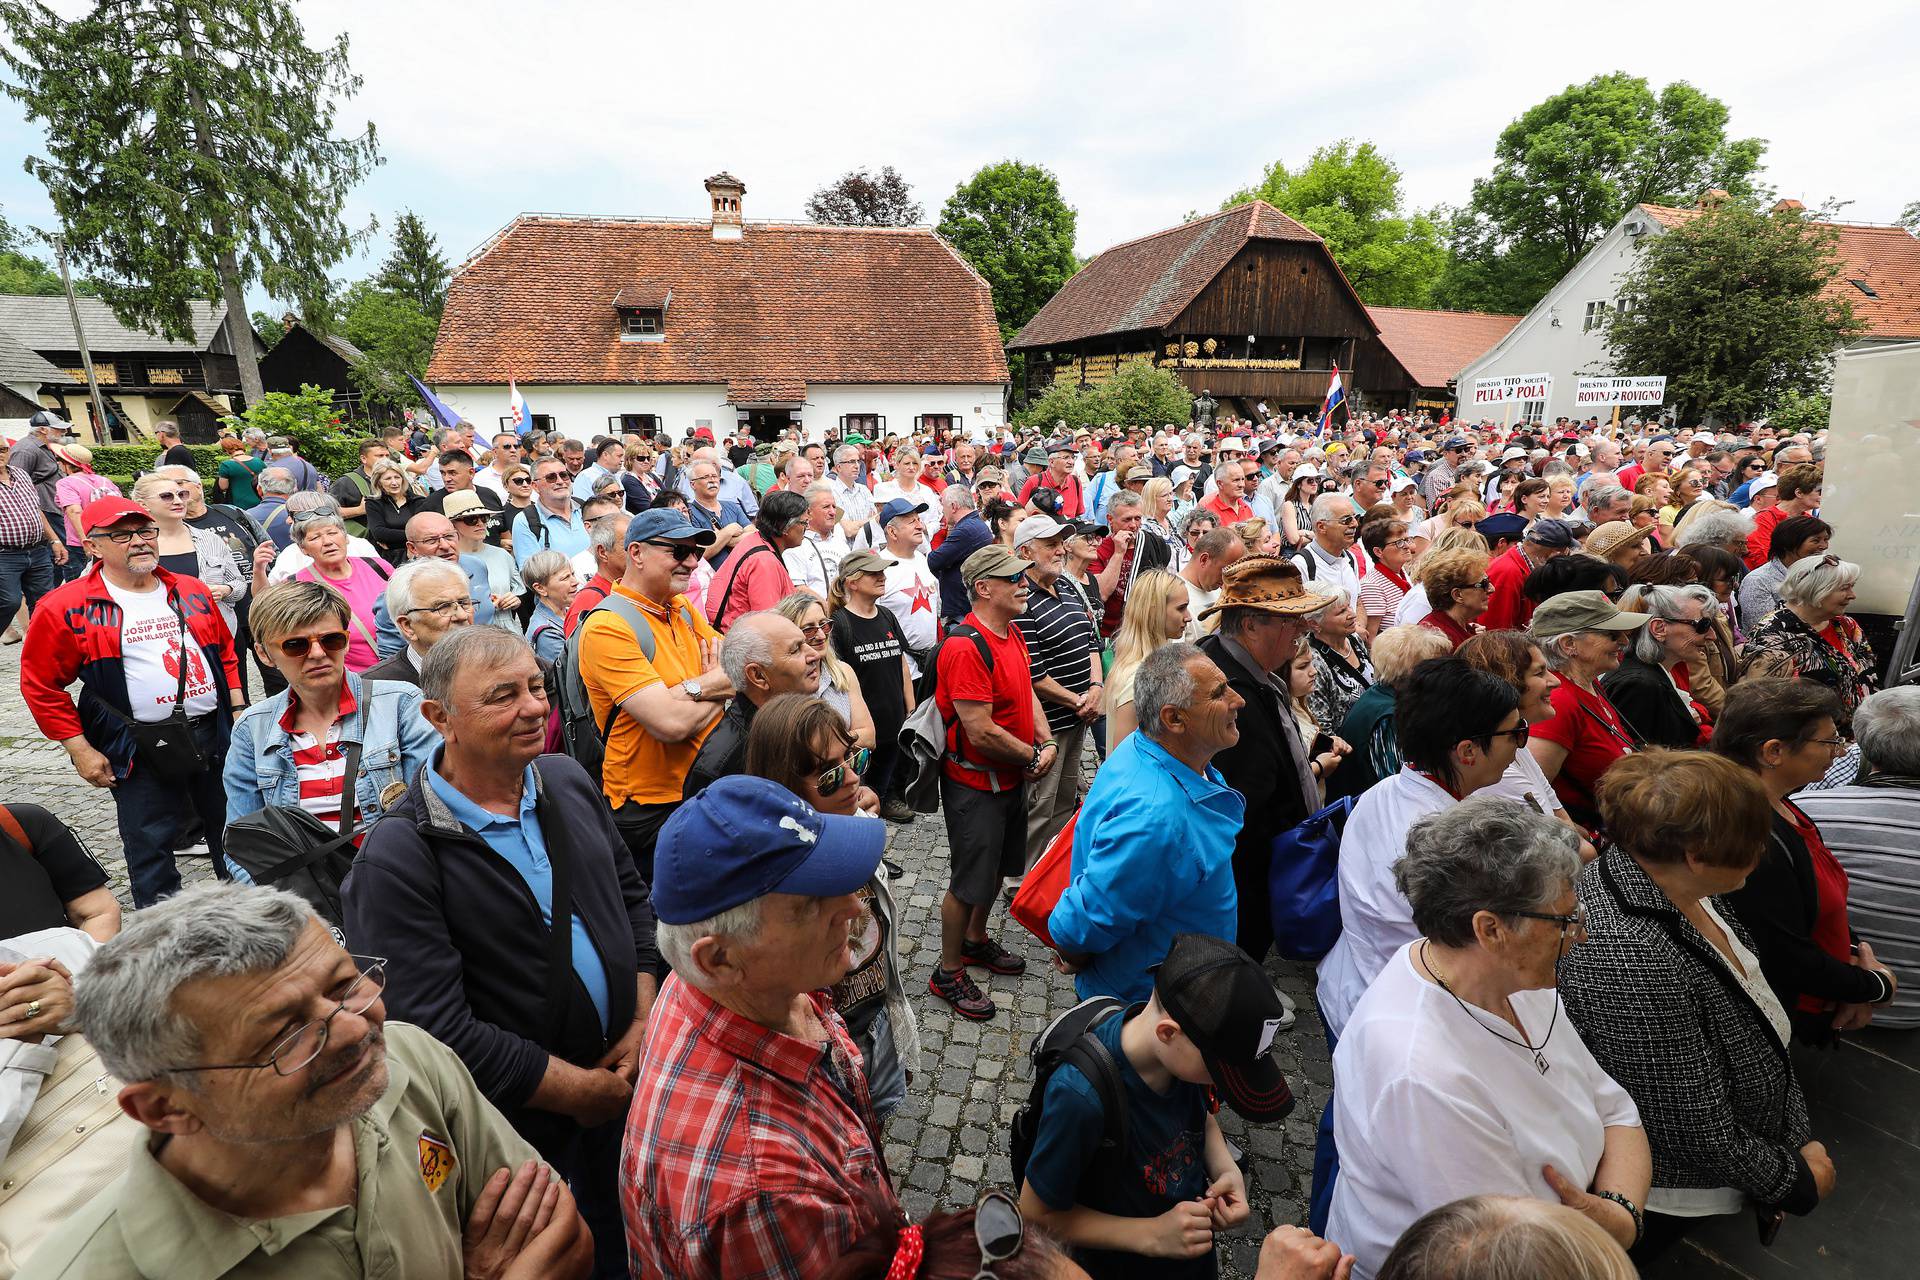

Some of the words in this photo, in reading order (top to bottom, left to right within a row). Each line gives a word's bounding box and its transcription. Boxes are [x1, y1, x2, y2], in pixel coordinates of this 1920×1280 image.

[1504, 377, 1521, 386] TITO
[1611, 379, 1632, 388] TITO
[1476, 388, 1503, 402] PULA
[1516, 384, 1544, 398] POLA
[1578, 391, 1610, 402] ROVINJ
[1620, 390, 1662, 401] ROVIGNO
[124, 625, 153, 637] JOSIP
[127, 636, 144, 644] DAN
